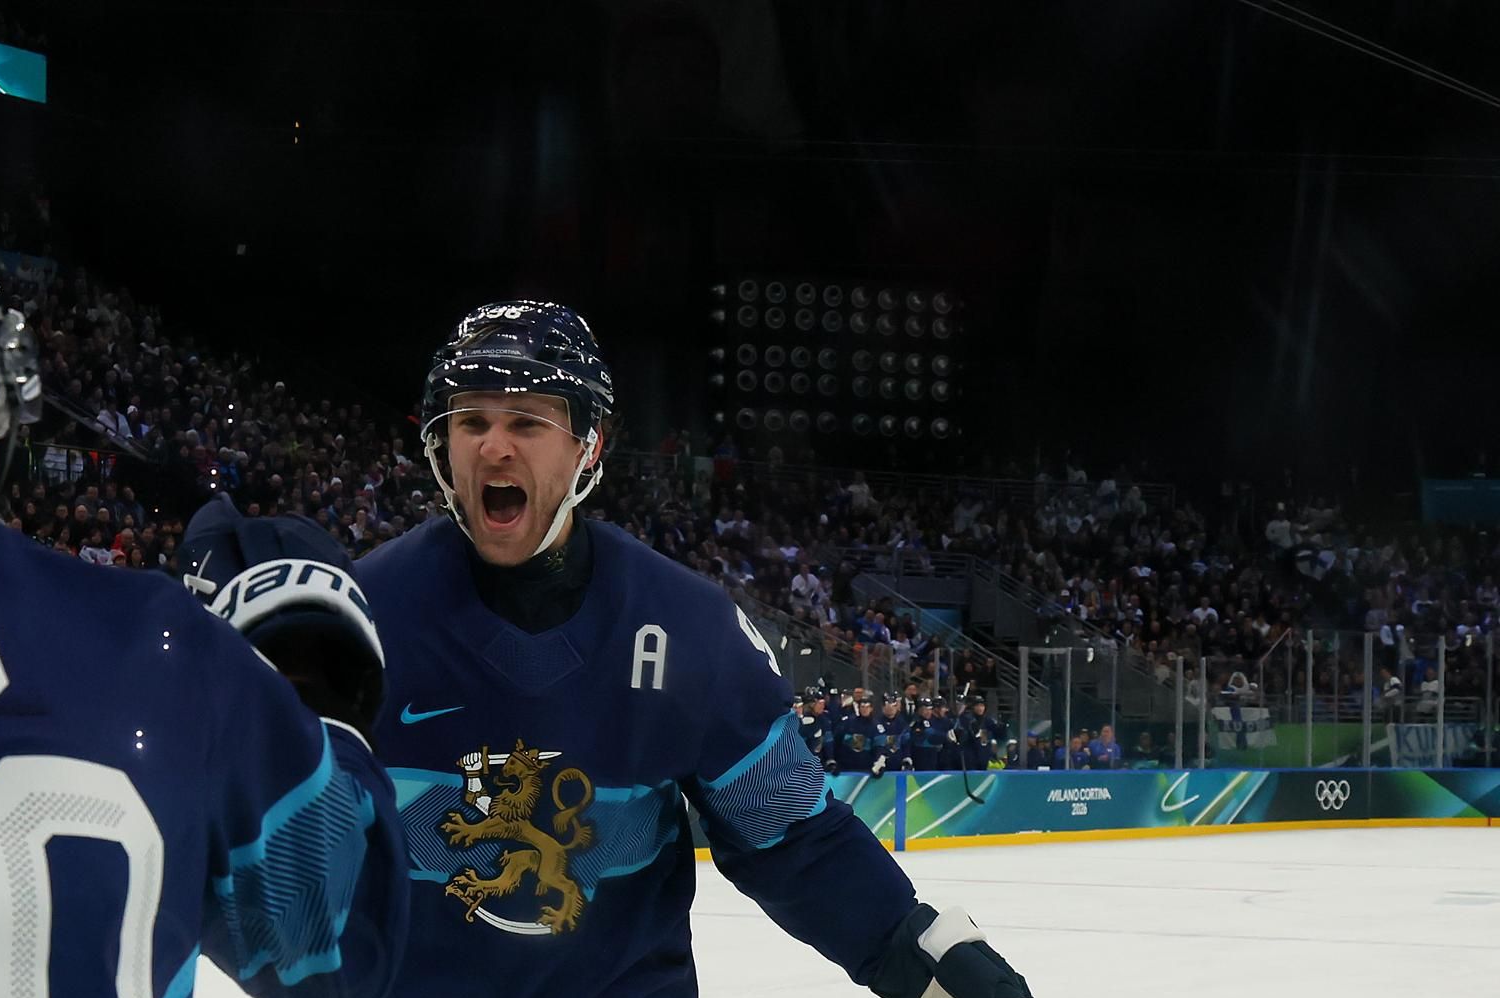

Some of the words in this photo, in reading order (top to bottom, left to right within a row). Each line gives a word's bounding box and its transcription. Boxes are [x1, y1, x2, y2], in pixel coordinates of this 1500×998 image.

[631, 624, 668, 690] A
[1047, 788, 1080, 803] MILANO
[1080, 787, 1112, 801] CORTINA
[1071, 802, 1088, 816] 2026
